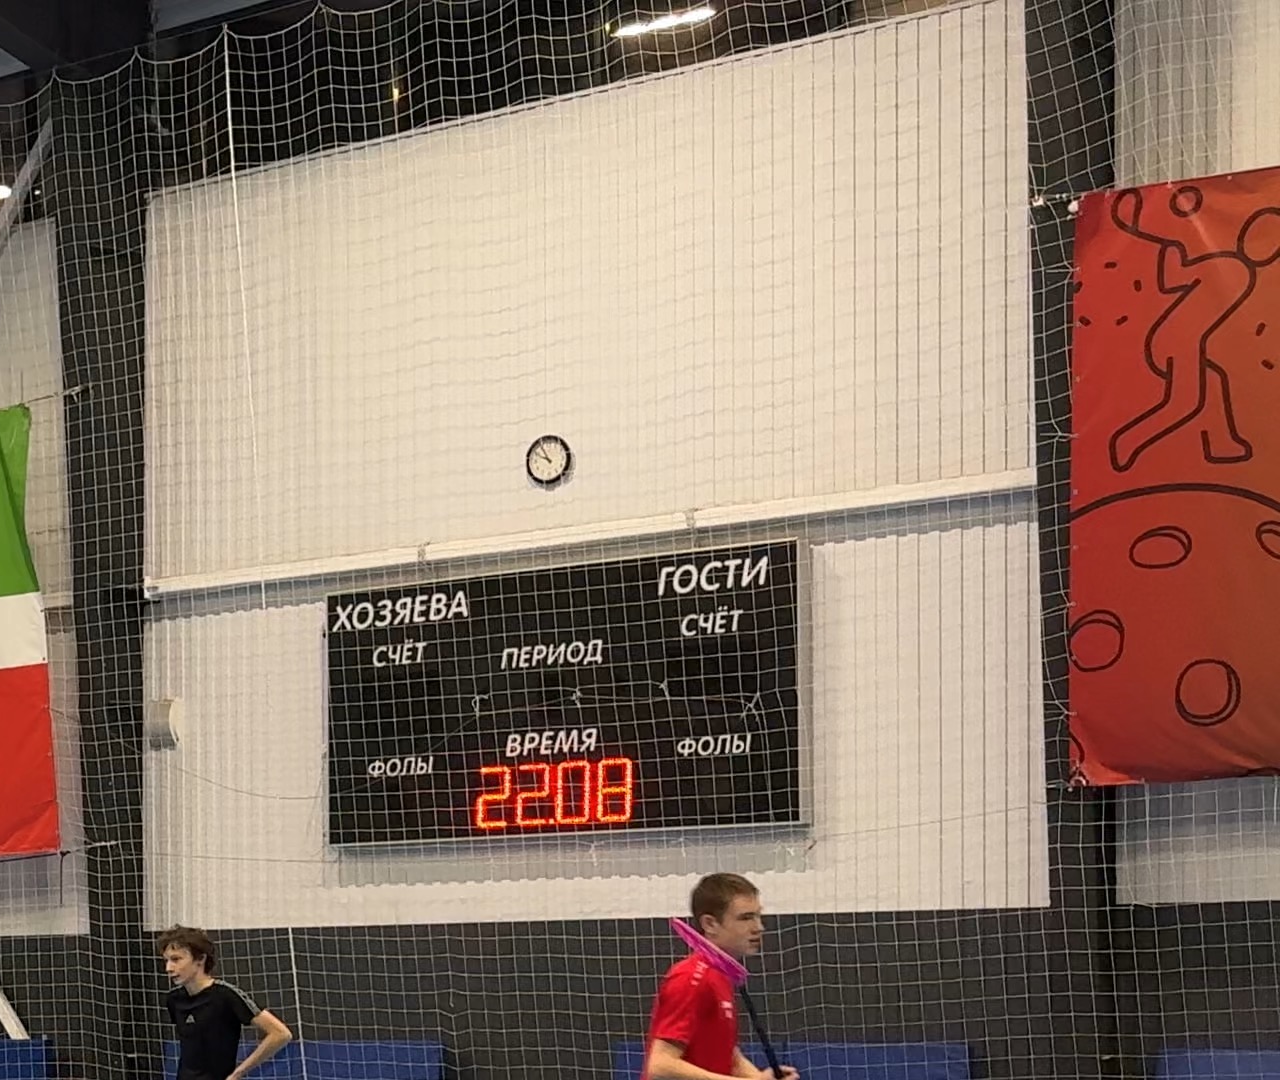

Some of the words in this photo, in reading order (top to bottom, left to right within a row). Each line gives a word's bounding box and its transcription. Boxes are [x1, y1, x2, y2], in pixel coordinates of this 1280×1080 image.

[657, 555, 769, 597] ГОСТИ
[332, 590, 469, 633] ХОЗЯЕВА
[680, 608, 743, 637] СЧЁТ
[372, 641, 427, 668] СЧЁТ
[500, 638, 604, 670] ПЕРИОД
[504, 727, 597, 757] ВРЕМЯ
[676, 733, 752, 757] ФОЛЫ
[367, 755, 434, 778] ФОЛЫ
